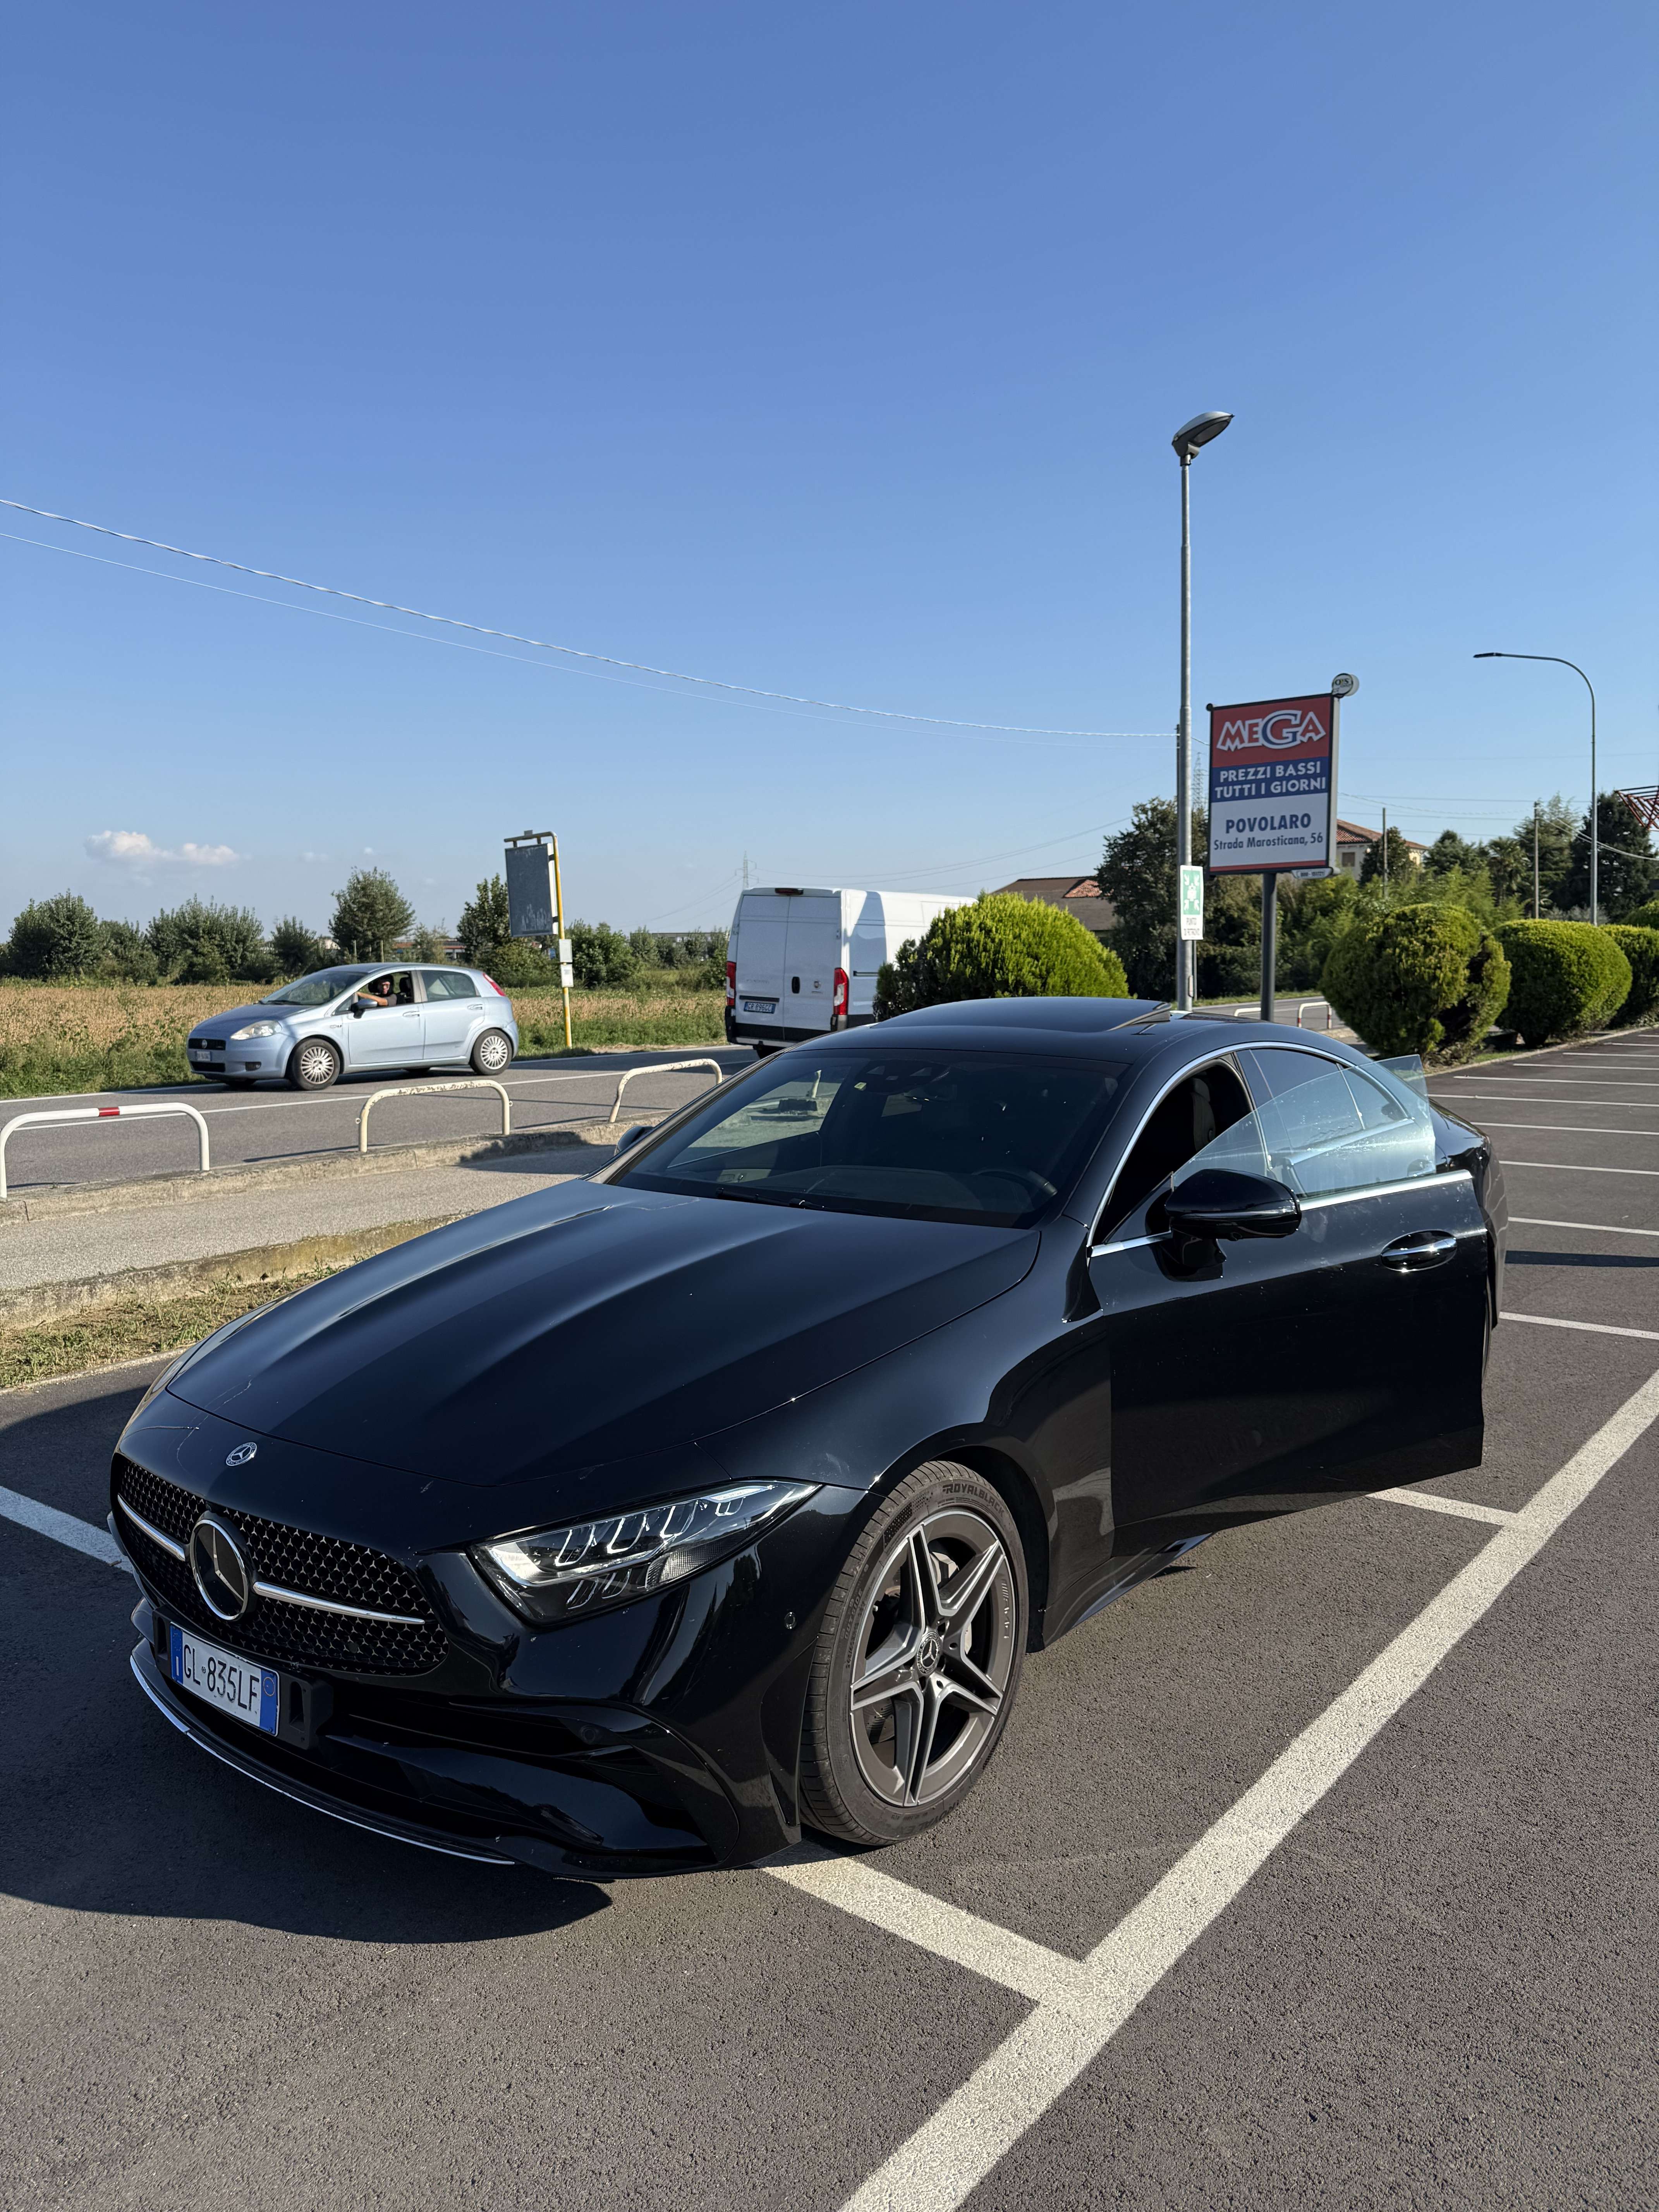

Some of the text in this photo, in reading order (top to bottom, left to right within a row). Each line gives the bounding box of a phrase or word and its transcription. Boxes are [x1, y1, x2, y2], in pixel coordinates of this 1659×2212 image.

[1216, 710, 1326, 752] MEGA
[1220, 761, 1320, 783] PREZZI BASSI
[1215, 777, 1326, 799] TUTTI I GIORNI
[1226, 813, 1311, 833] POVOLARO
[1214, 832, 1323, 850] Strada Marosticana, 56
[942, 1484, 1005, 1518] ROYALBLACK
